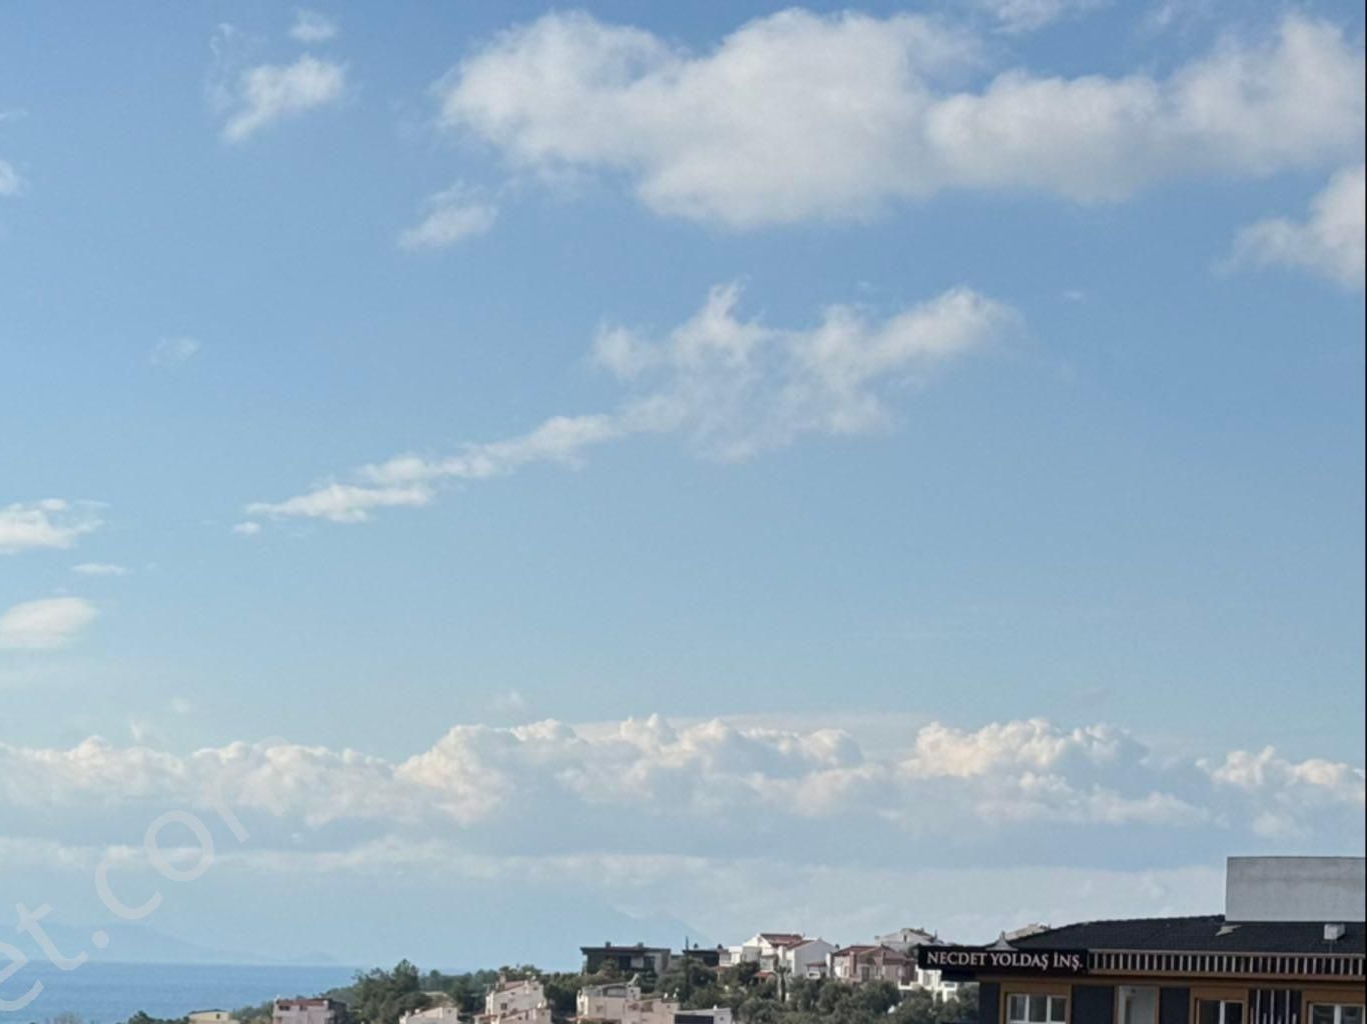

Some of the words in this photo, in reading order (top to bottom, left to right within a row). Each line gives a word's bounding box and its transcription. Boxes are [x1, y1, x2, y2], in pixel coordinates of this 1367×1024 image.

[927, 951, 987, 966] NECDET
[990, 952, 1048, 971] YOLDAŞ
[1053, 951, 1083, 971] İNŞ.
